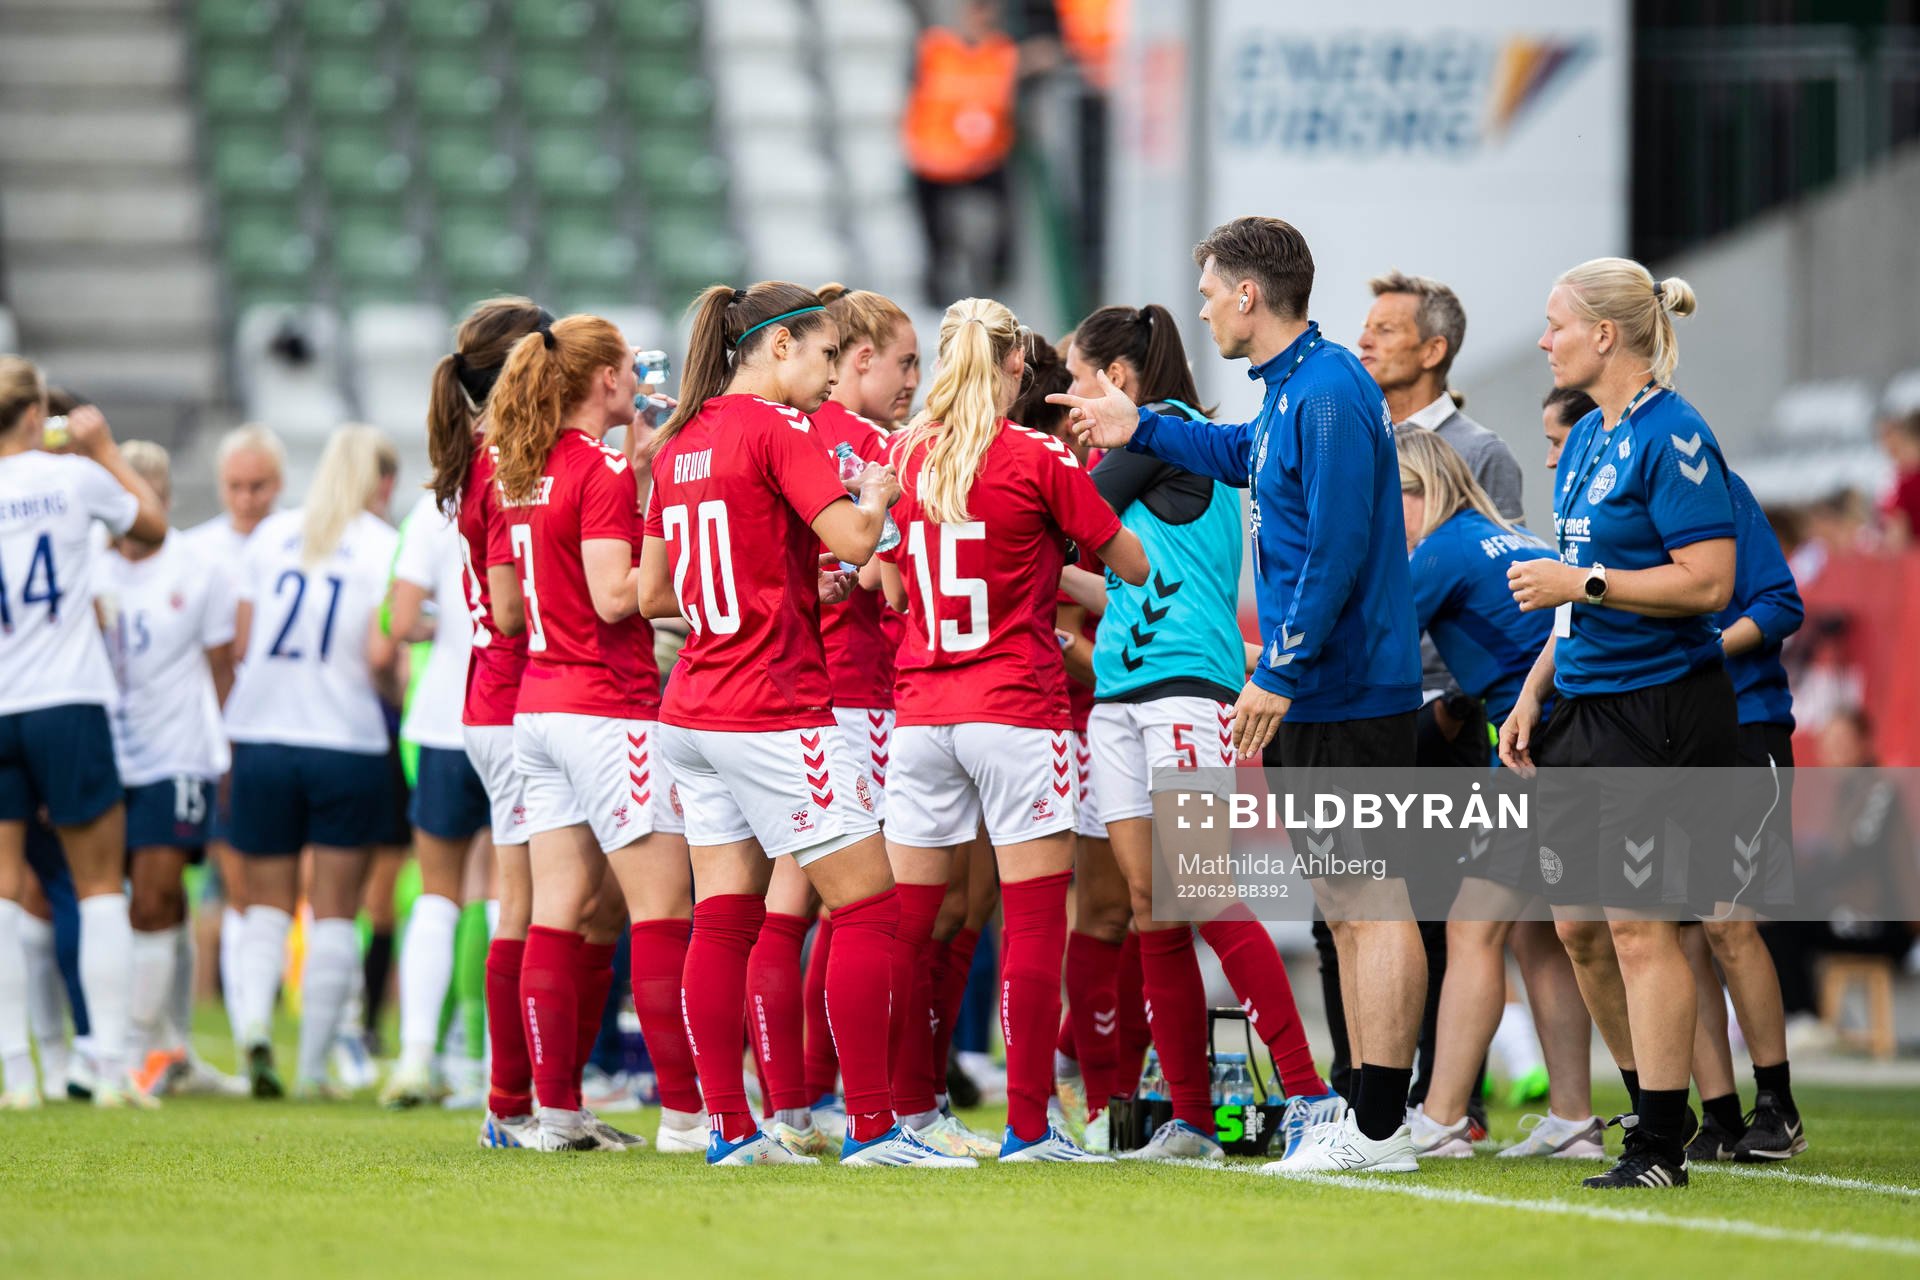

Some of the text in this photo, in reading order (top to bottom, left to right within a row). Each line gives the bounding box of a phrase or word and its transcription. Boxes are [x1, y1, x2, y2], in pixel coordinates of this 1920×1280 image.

[673, 448, 713, 484] BRUUN
[662, 500, 741, 636] 20
[907, 520, 990, 653] 15
[267, 569, 342, 662] 21
[1173, 723, 1198, 772] 5
[1215, 1104, 1244, 1143] S
[1245, 1104, 1257, 1142] SPORT
